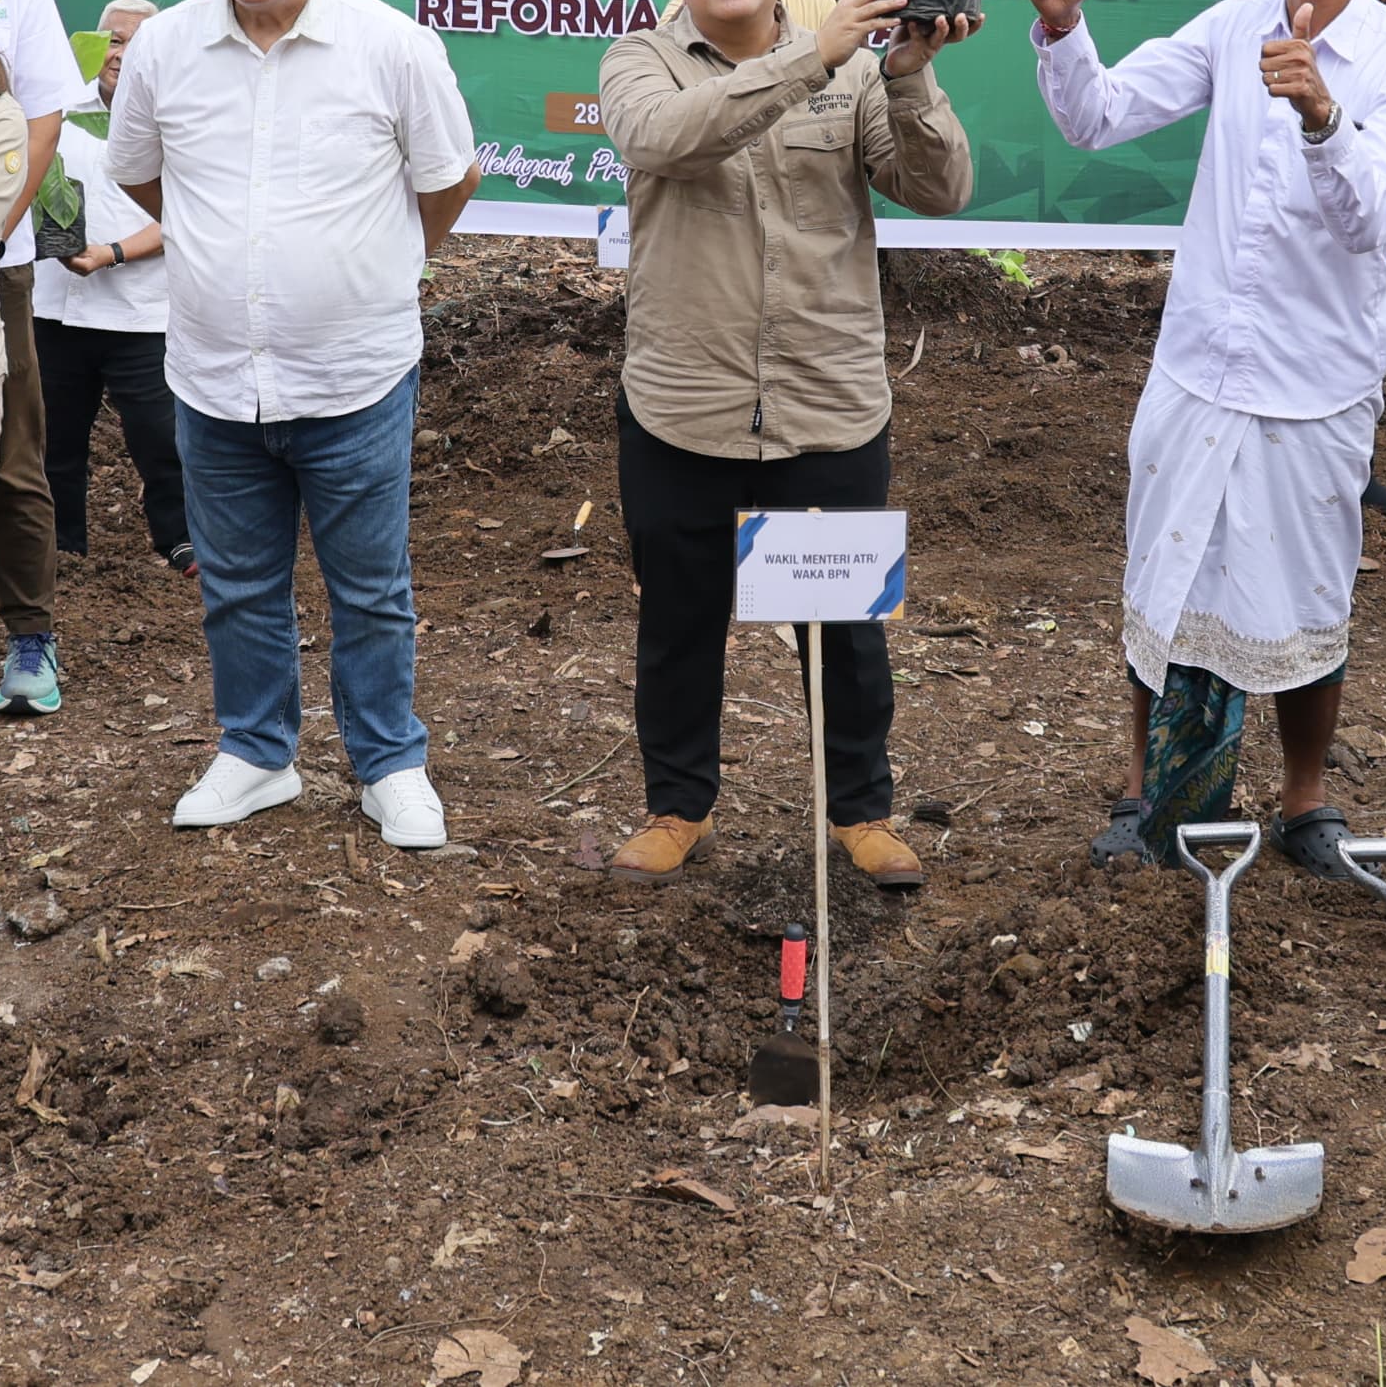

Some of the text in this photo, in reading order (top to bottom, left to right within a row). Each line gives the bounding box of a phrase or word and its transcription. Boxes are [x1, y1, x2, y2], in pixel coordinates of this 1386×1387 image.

[808, 93, 853, 106] Reforma
[573, 102, 600, 125] 28
[808, 101, 850, 115] Agraria
[764, 552, 879, 565] WAKIL MENTERI ATR/
[792, 569, 850, 580] WAKA BPN
